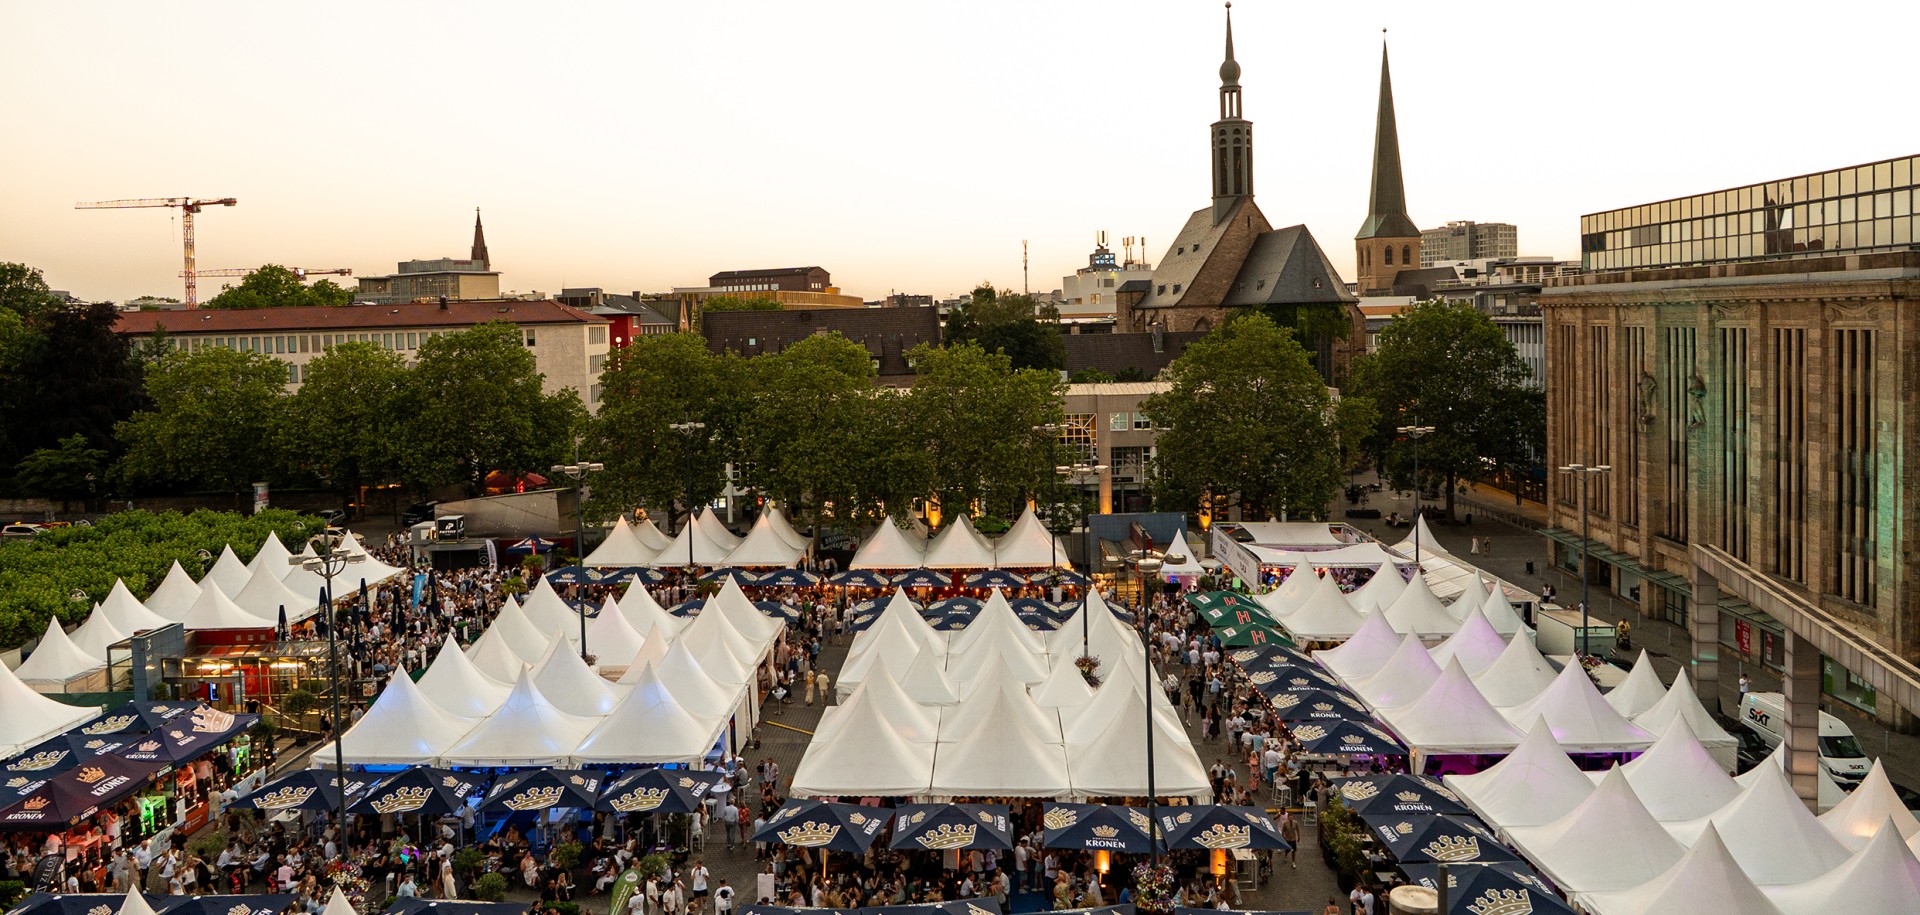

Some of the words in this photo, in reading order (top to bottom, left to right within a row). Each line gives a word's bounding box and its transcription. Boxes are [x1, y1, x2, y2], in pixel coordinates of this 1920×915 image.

[1223, 597, 1238, 606] H
[1236, 610, 1251, 625] H
[1251, 630, 1267, 645] H
[91, 775, 130, 797] KRONEN
[1378, 824, 1399, 844] KRONEN
[1085, 839, 1126, 849] KRONEN
[40, 854, 58, 883] ZELOS
